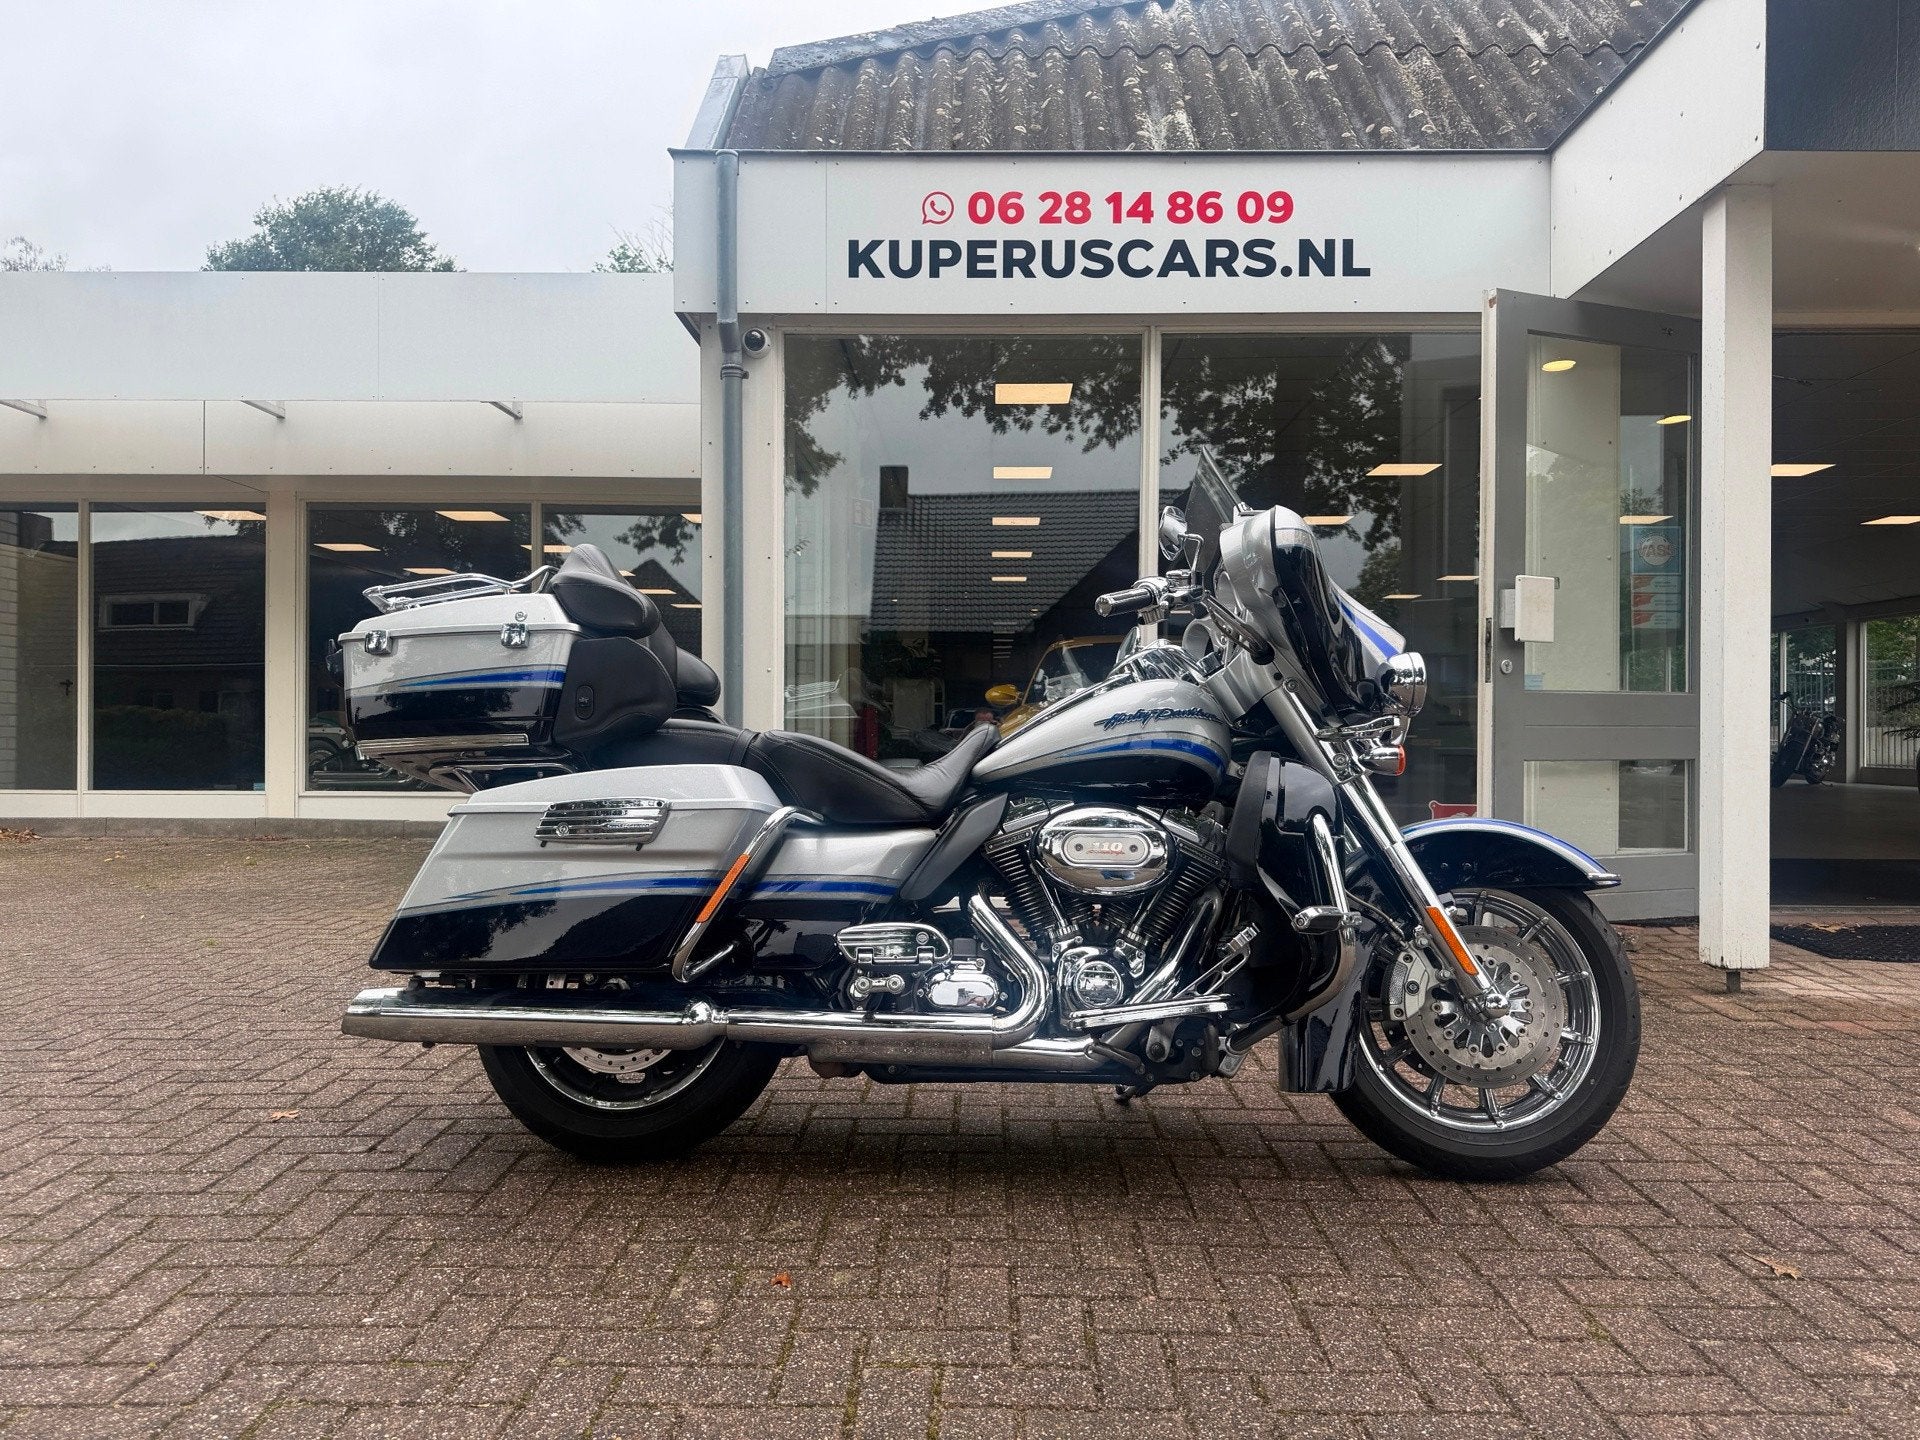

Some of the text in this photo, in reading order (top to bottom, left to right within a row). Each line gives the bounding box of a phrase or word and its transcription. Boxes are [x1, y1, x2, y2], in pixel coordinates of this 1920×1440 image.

[967, 190, 1294, 224] 06 28 14 86 09
[848, 238, 1371, 279] KUPERUSCARS.NL
